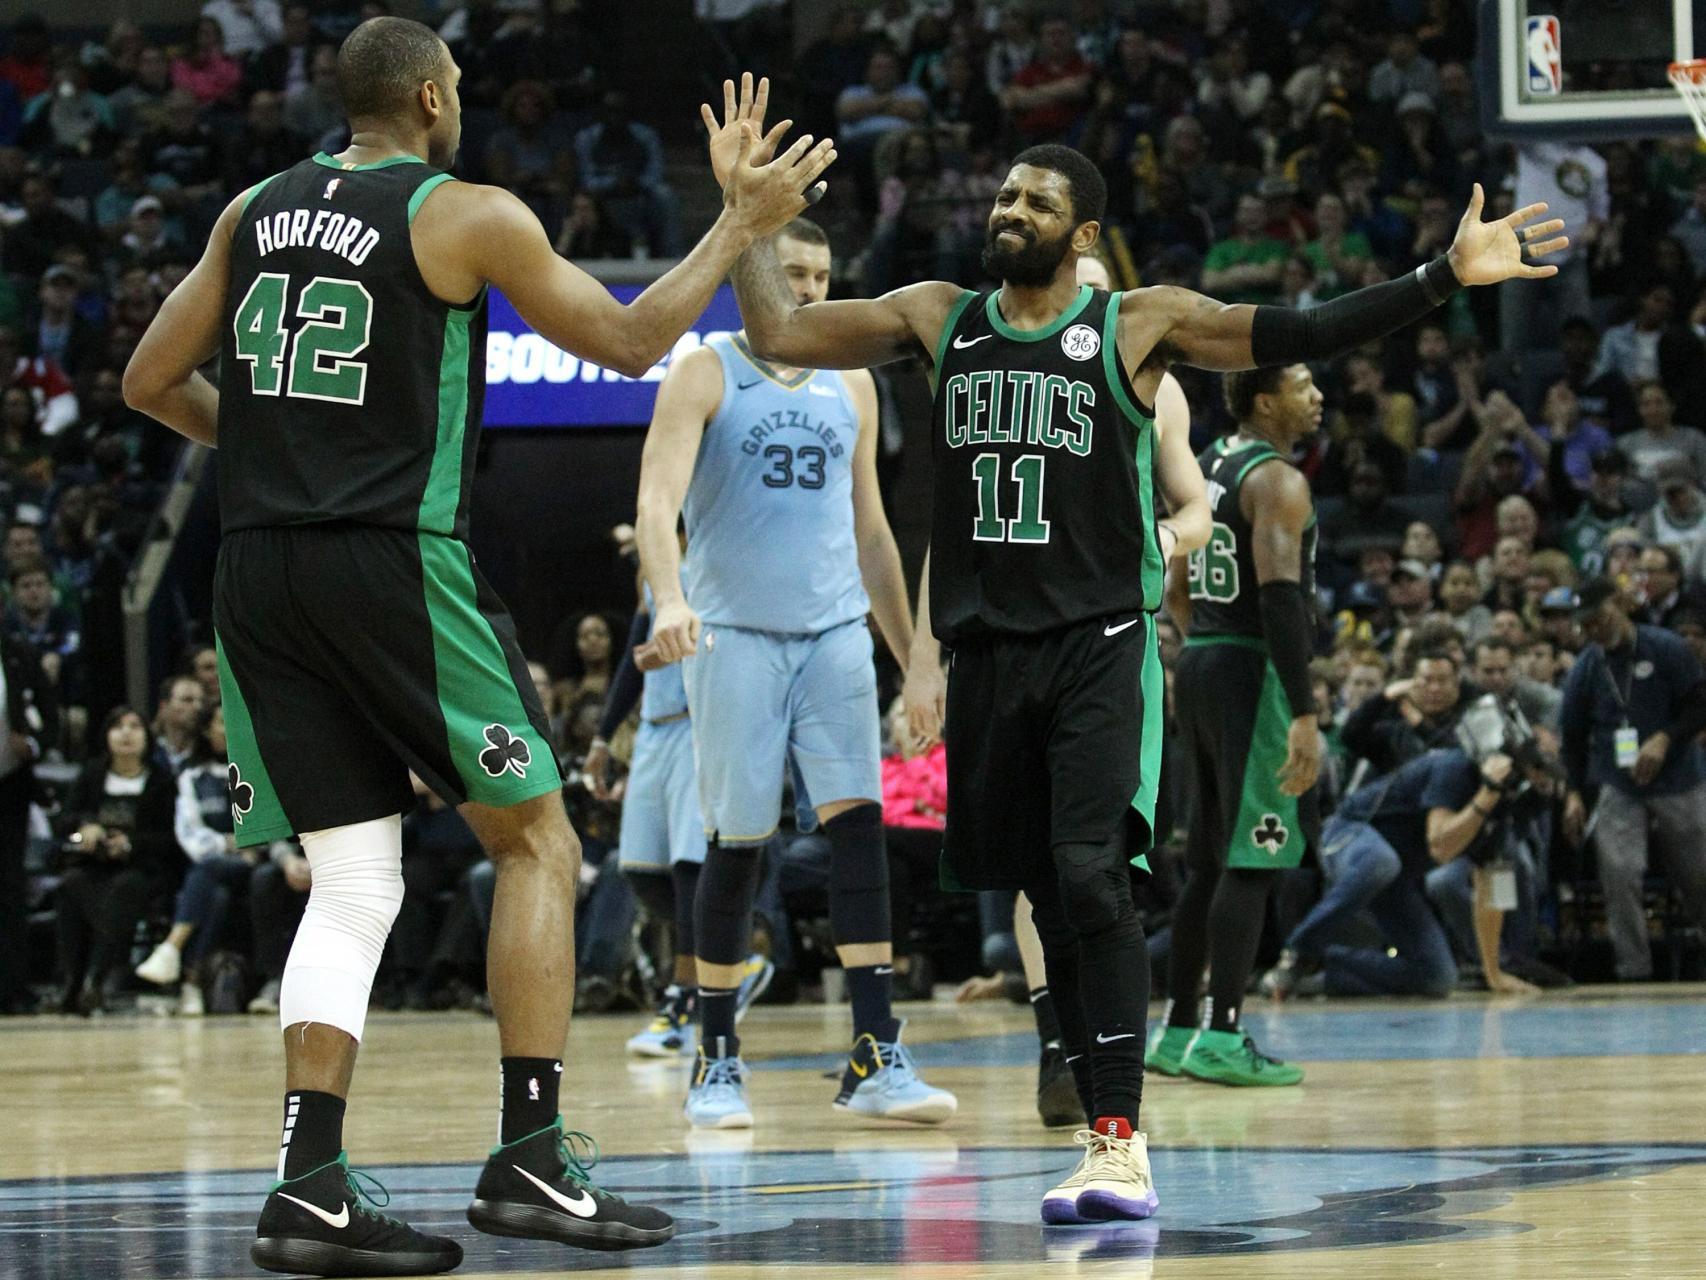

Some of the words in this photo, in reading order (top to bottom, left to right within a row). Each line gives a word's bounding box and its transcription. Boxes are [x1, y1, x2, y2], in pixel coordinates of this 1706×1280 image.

[255, 208, 380, 266] HORFORD
[233, 271, 374, 406] 42
[741, 409, 845, 459] GRIZZLIES
[946, 369, 1096, 457] CELTICS
[762, 444, 827, 490] 33
[972, 452, 1050, 544] 11
